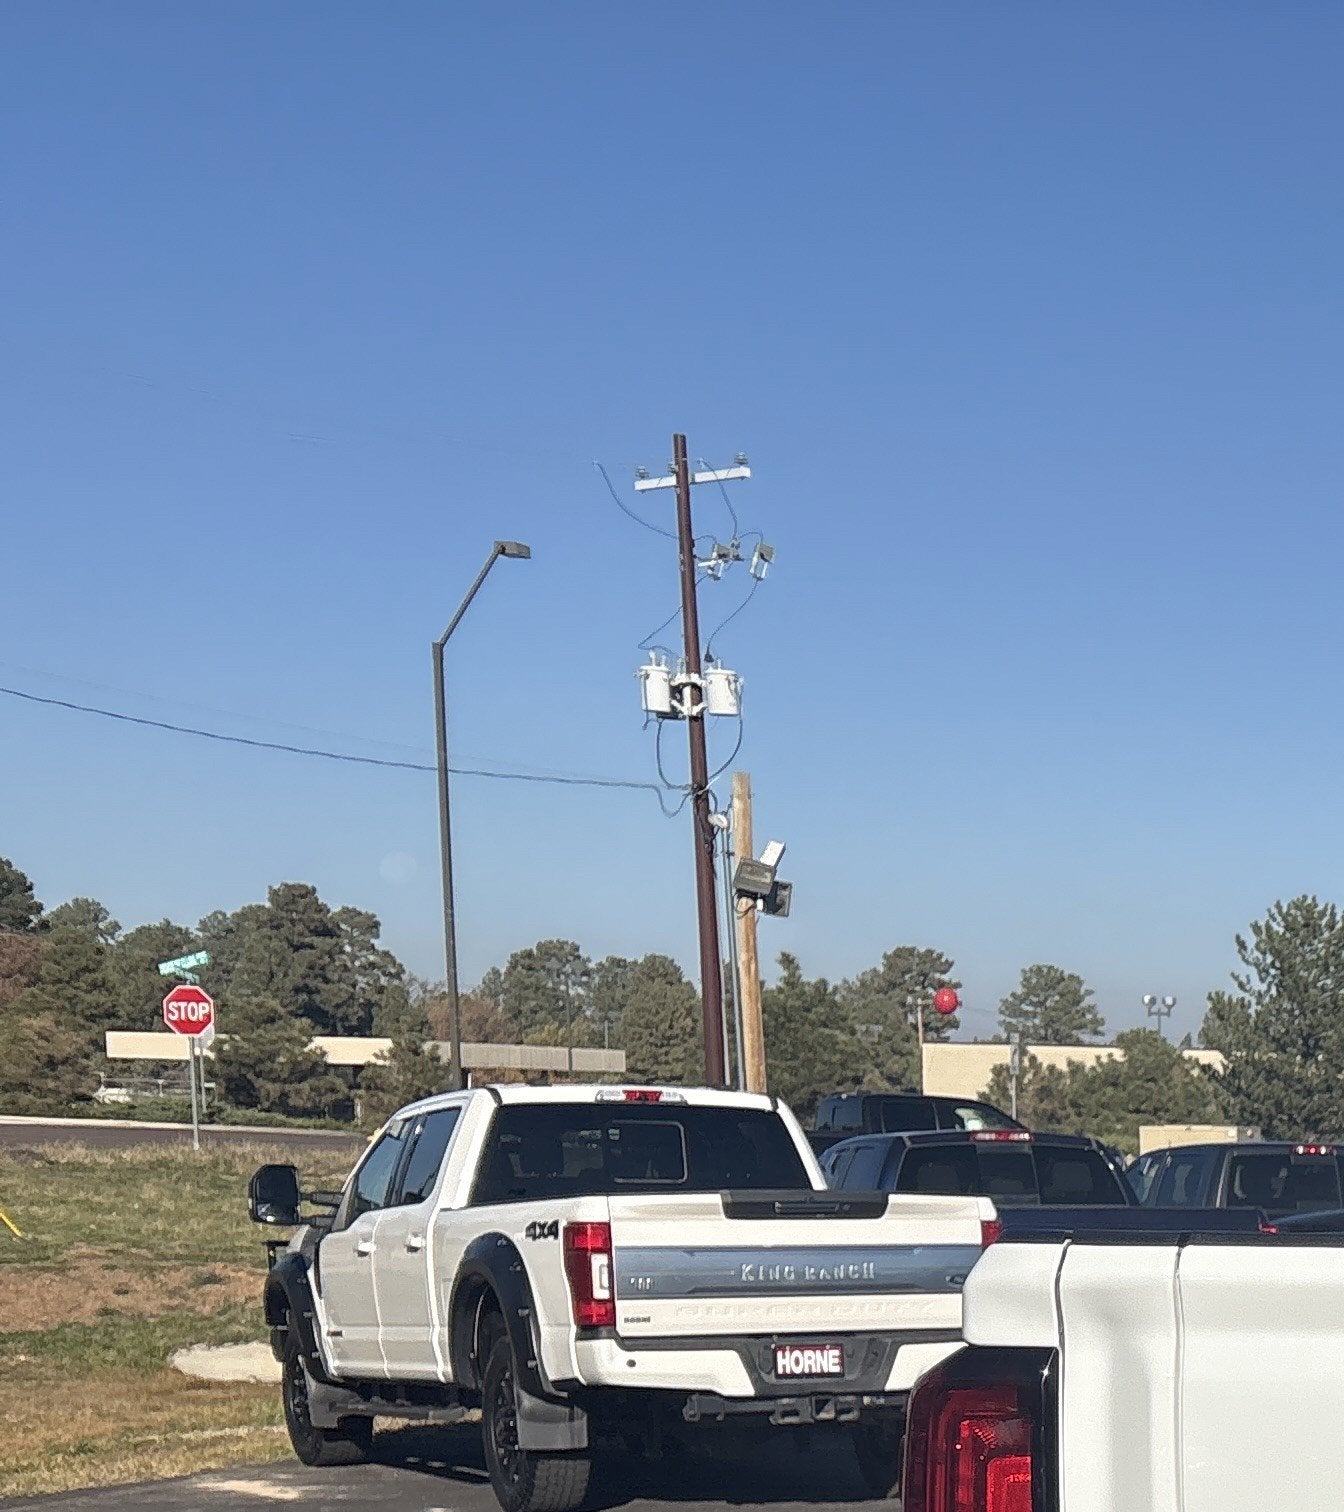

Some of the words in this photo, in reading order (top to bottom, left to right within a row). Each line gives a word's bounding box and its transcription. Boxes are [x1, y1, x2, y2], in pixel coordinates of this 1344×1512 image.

[167, 1001, 210, 1021] STOP
[741, 1263, 795, 1281] KING
[805, 1262, 875, 1280] RANCH
[776, 1349, 842, 1375] HORNE
